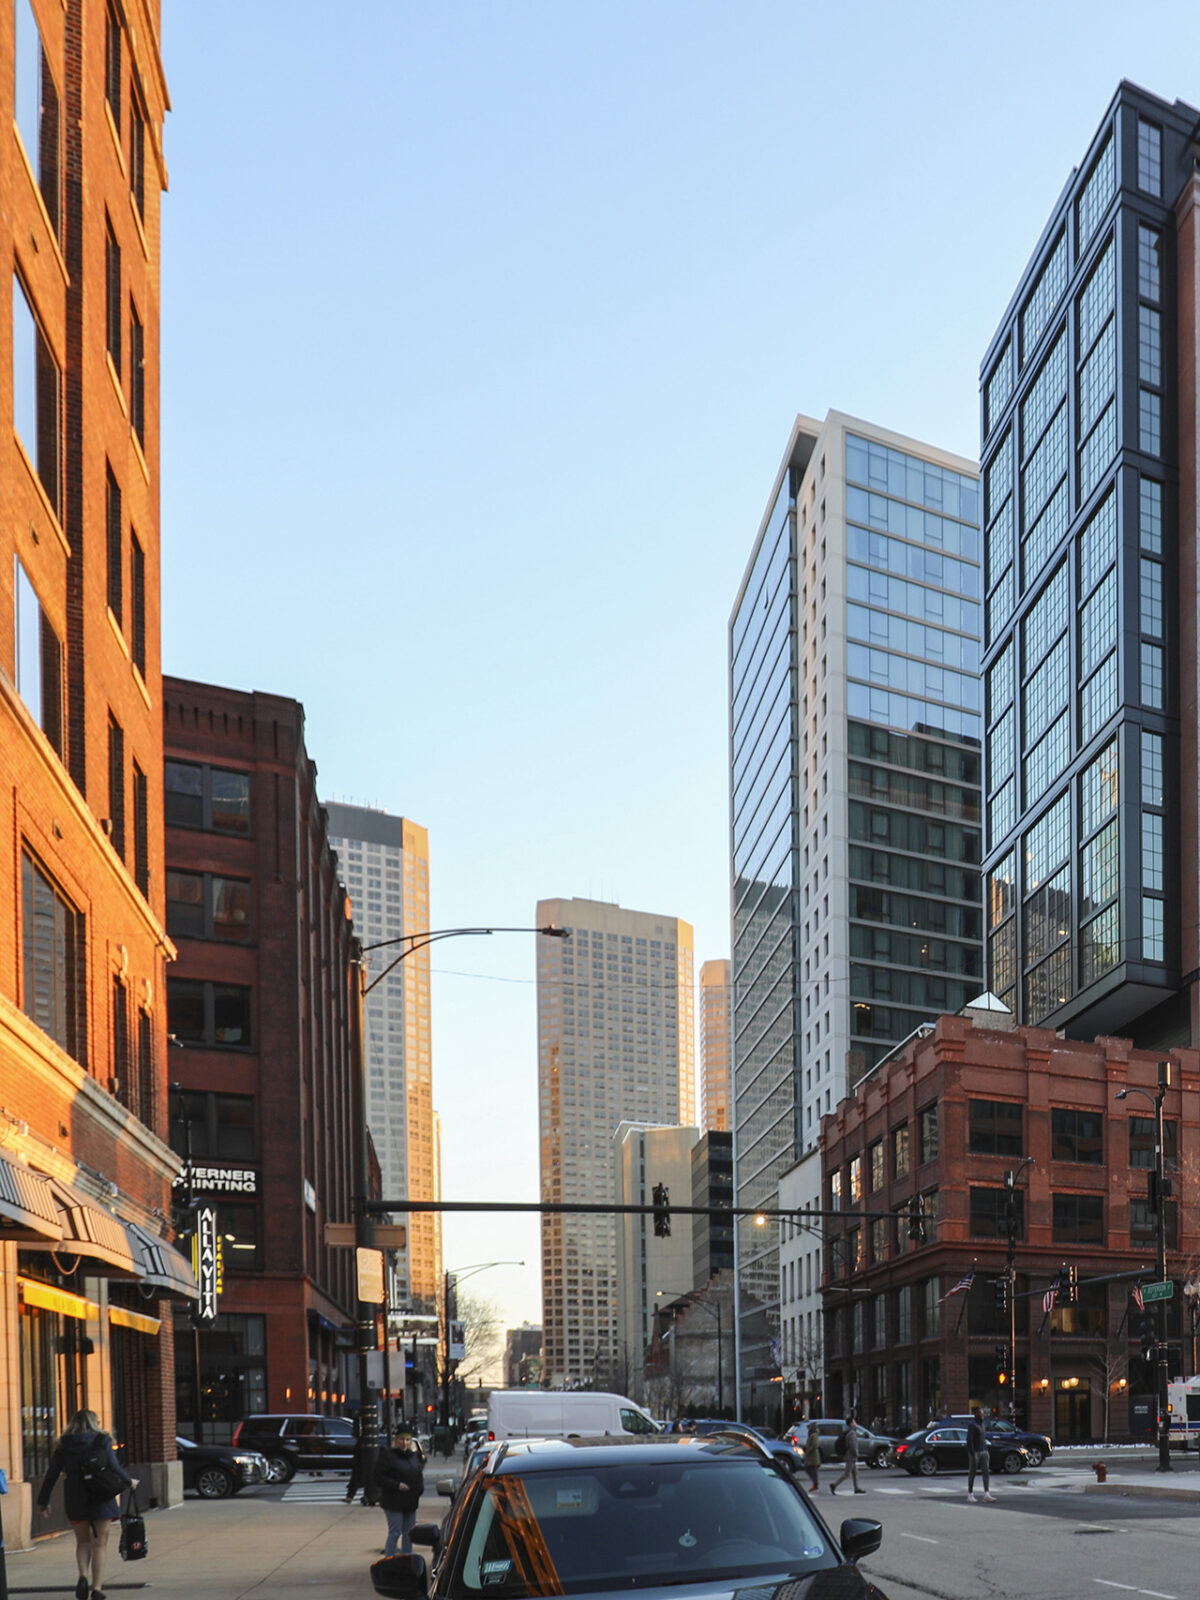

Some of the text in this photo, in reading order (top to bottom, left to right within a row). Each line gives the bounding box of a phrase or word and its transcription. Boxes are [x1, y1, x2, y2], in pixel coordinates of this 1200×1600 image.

[180, 1167, 256, 1181] WERNER
[201, 1207, 214, 1319] ALLA VITA
